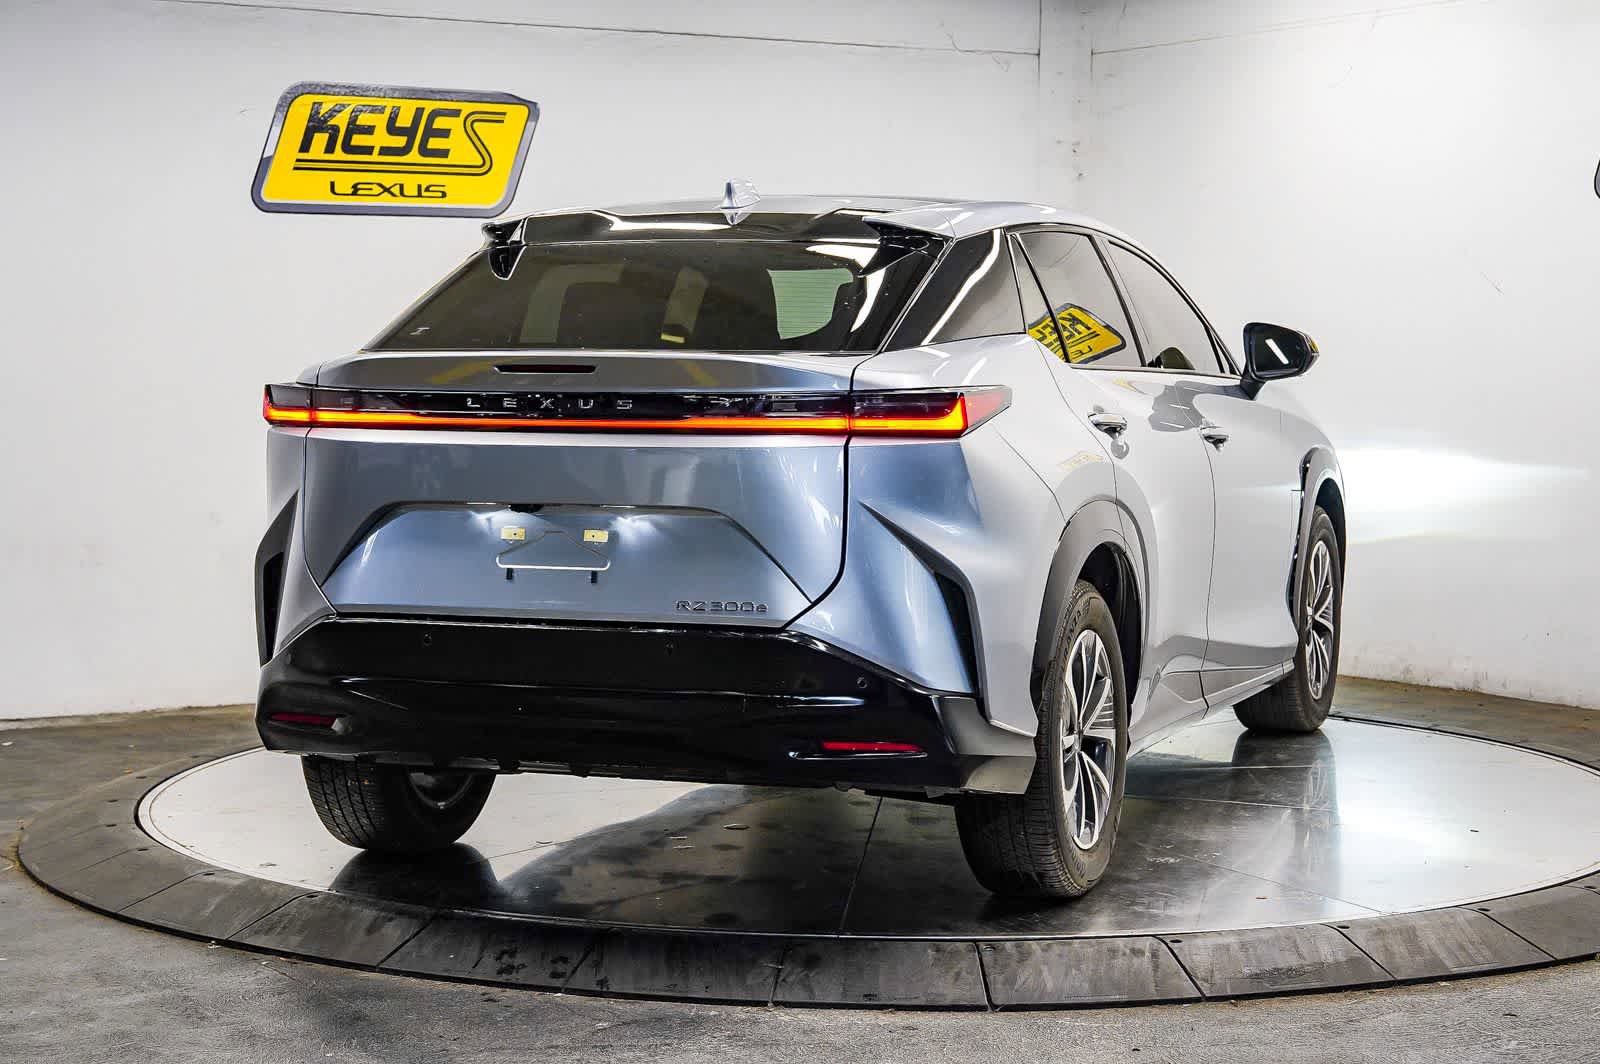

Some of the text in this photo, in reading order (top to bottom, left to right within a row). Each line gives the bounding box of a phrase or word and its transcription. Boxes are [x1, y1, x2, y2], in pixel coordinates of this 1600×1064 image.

[297, 101, 507, 176] KEYES
[329, 180, 447, 199] LEXUS
[466, 397, 632, 410] LEXUS
